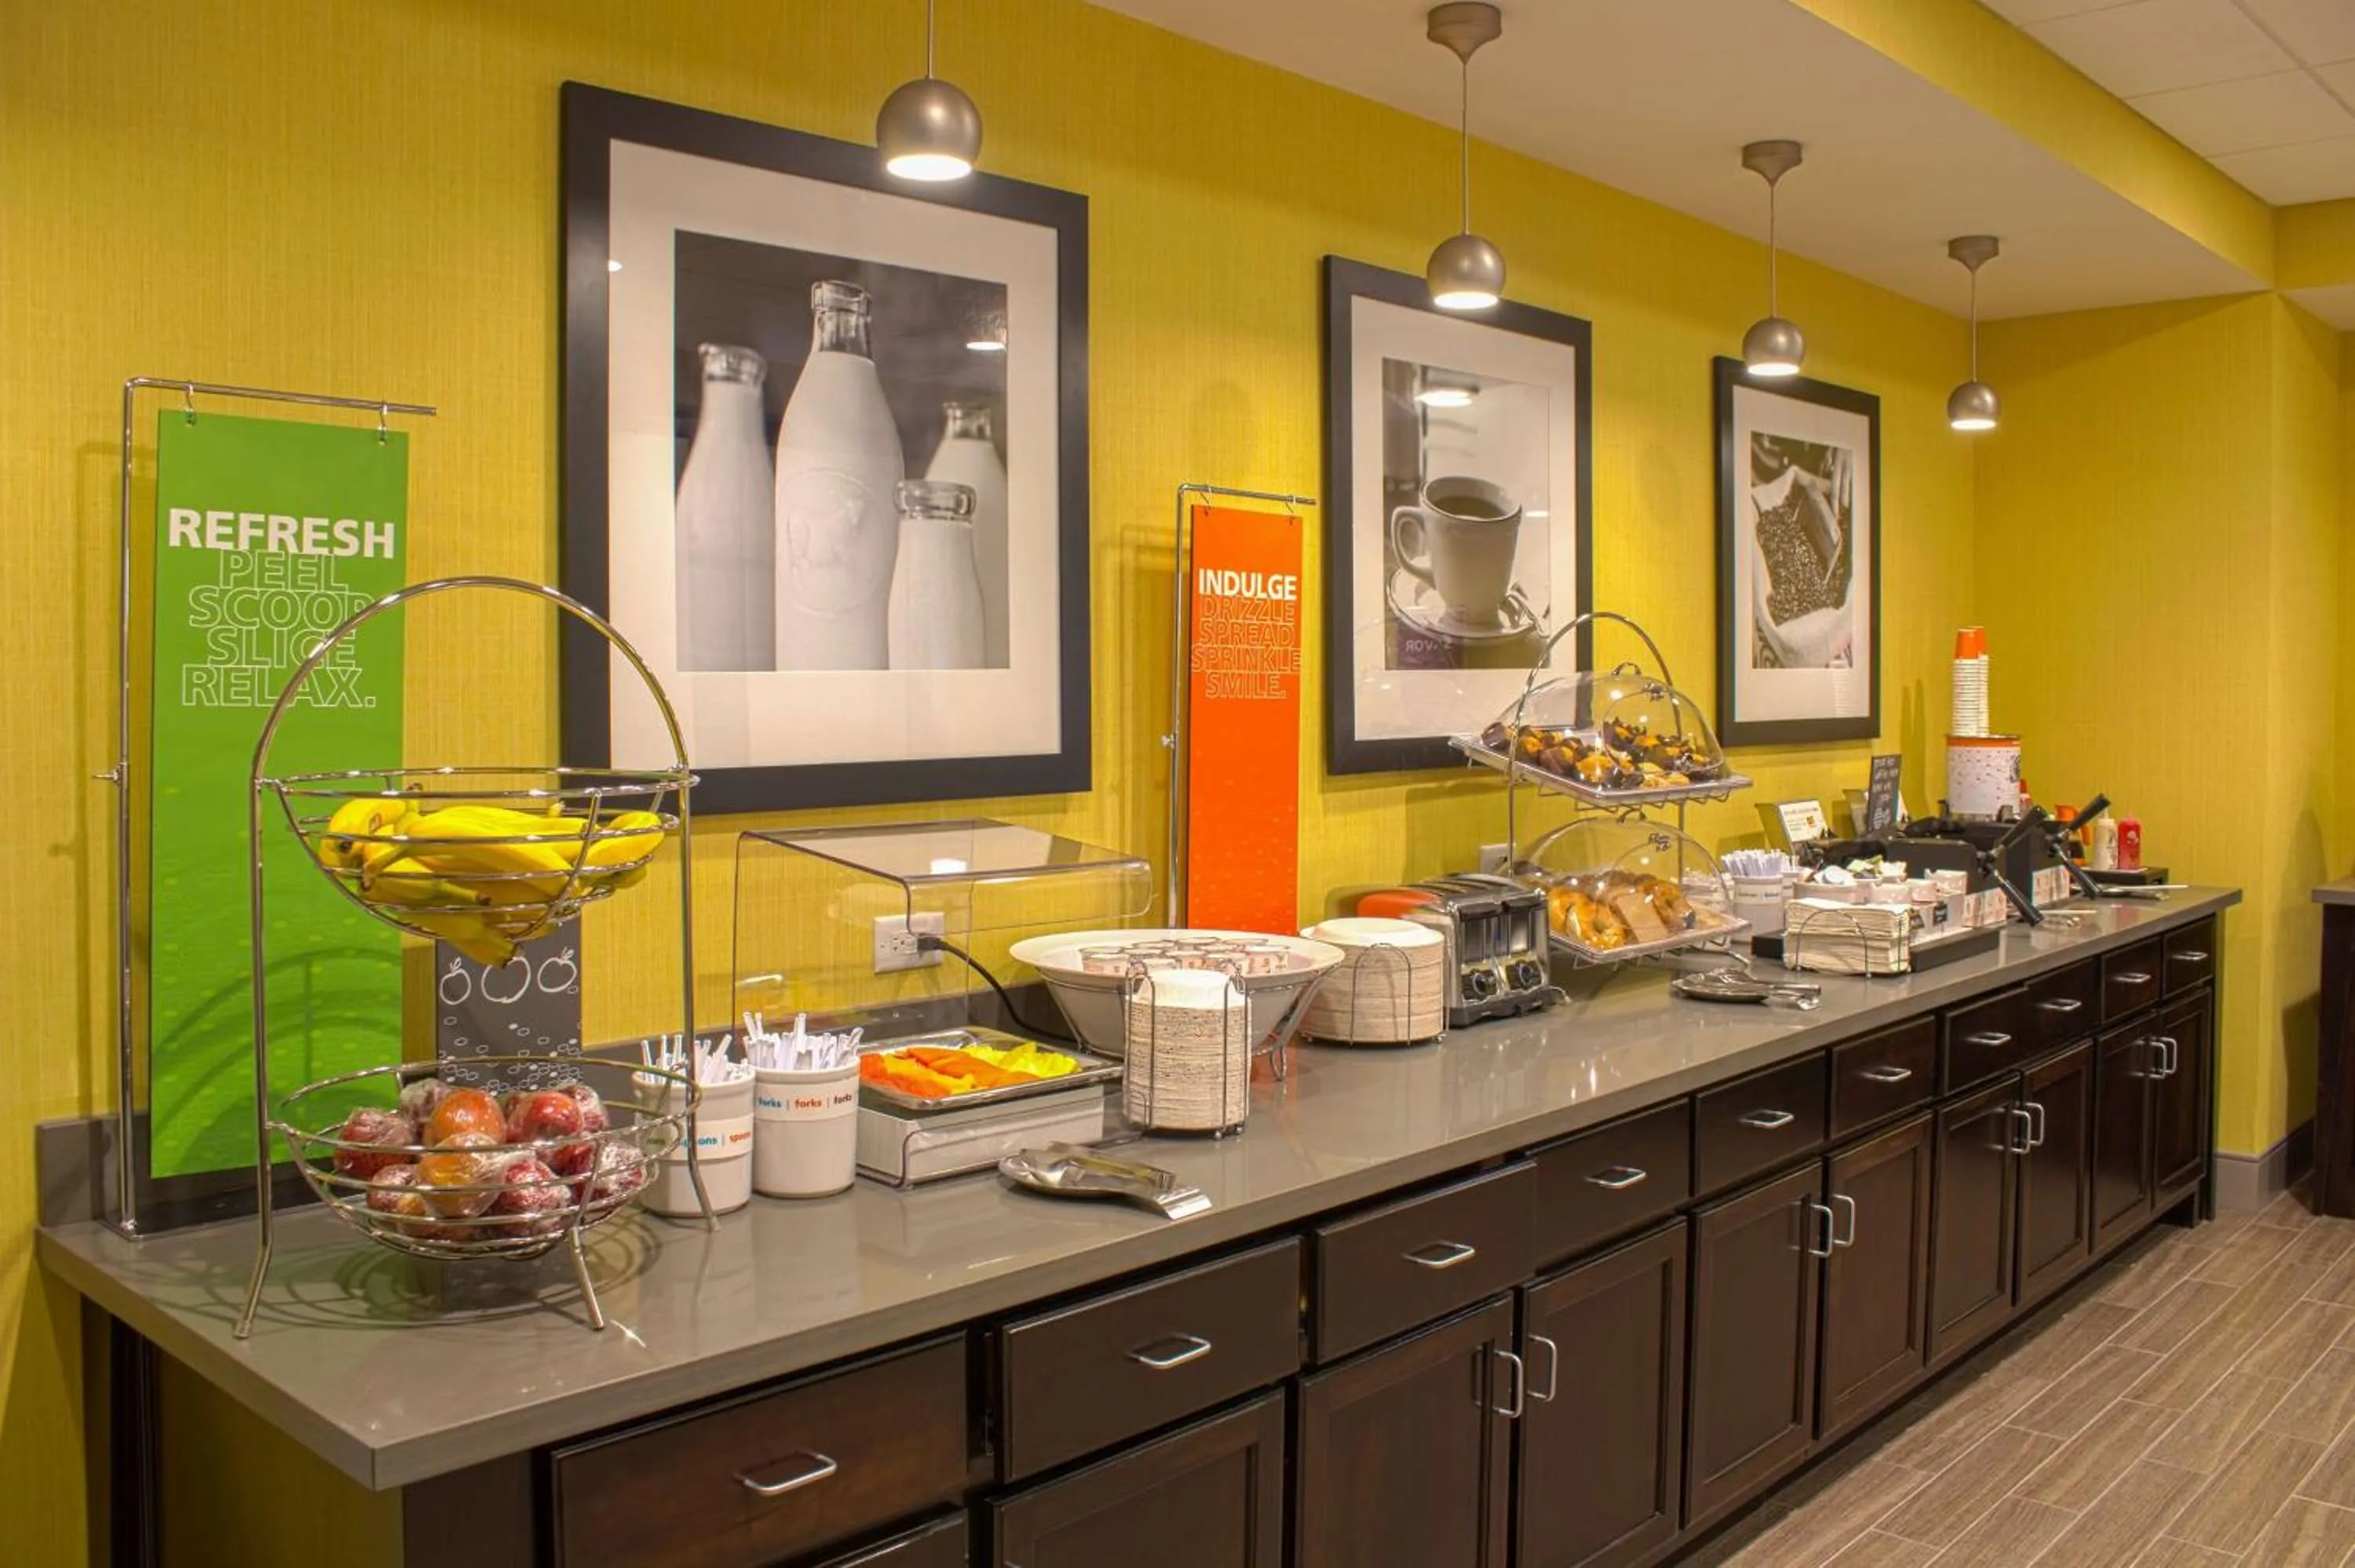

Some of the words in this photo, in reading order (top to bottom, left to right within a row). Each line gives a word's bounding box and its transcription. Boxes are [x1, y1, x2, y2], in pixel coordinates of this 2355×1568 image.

[168, 508, 394, 559] REFRESH
[220, 549, 349, 592] PEEL
[1199, 568, 1298, 600] INDULGE
[189, 585, 375, 632] SCOOP
[1201, 596, 1295, 624] DRIZZLE
[1199, 618, 1294, 648] SPREAD
[1192, 644, 1302, 673] SPRINKLE
[181, 664, 376, 708] RELAX.
[1205, 669, 1287, 699] SMILE.
[794, 1098, 822, 1109] forks
